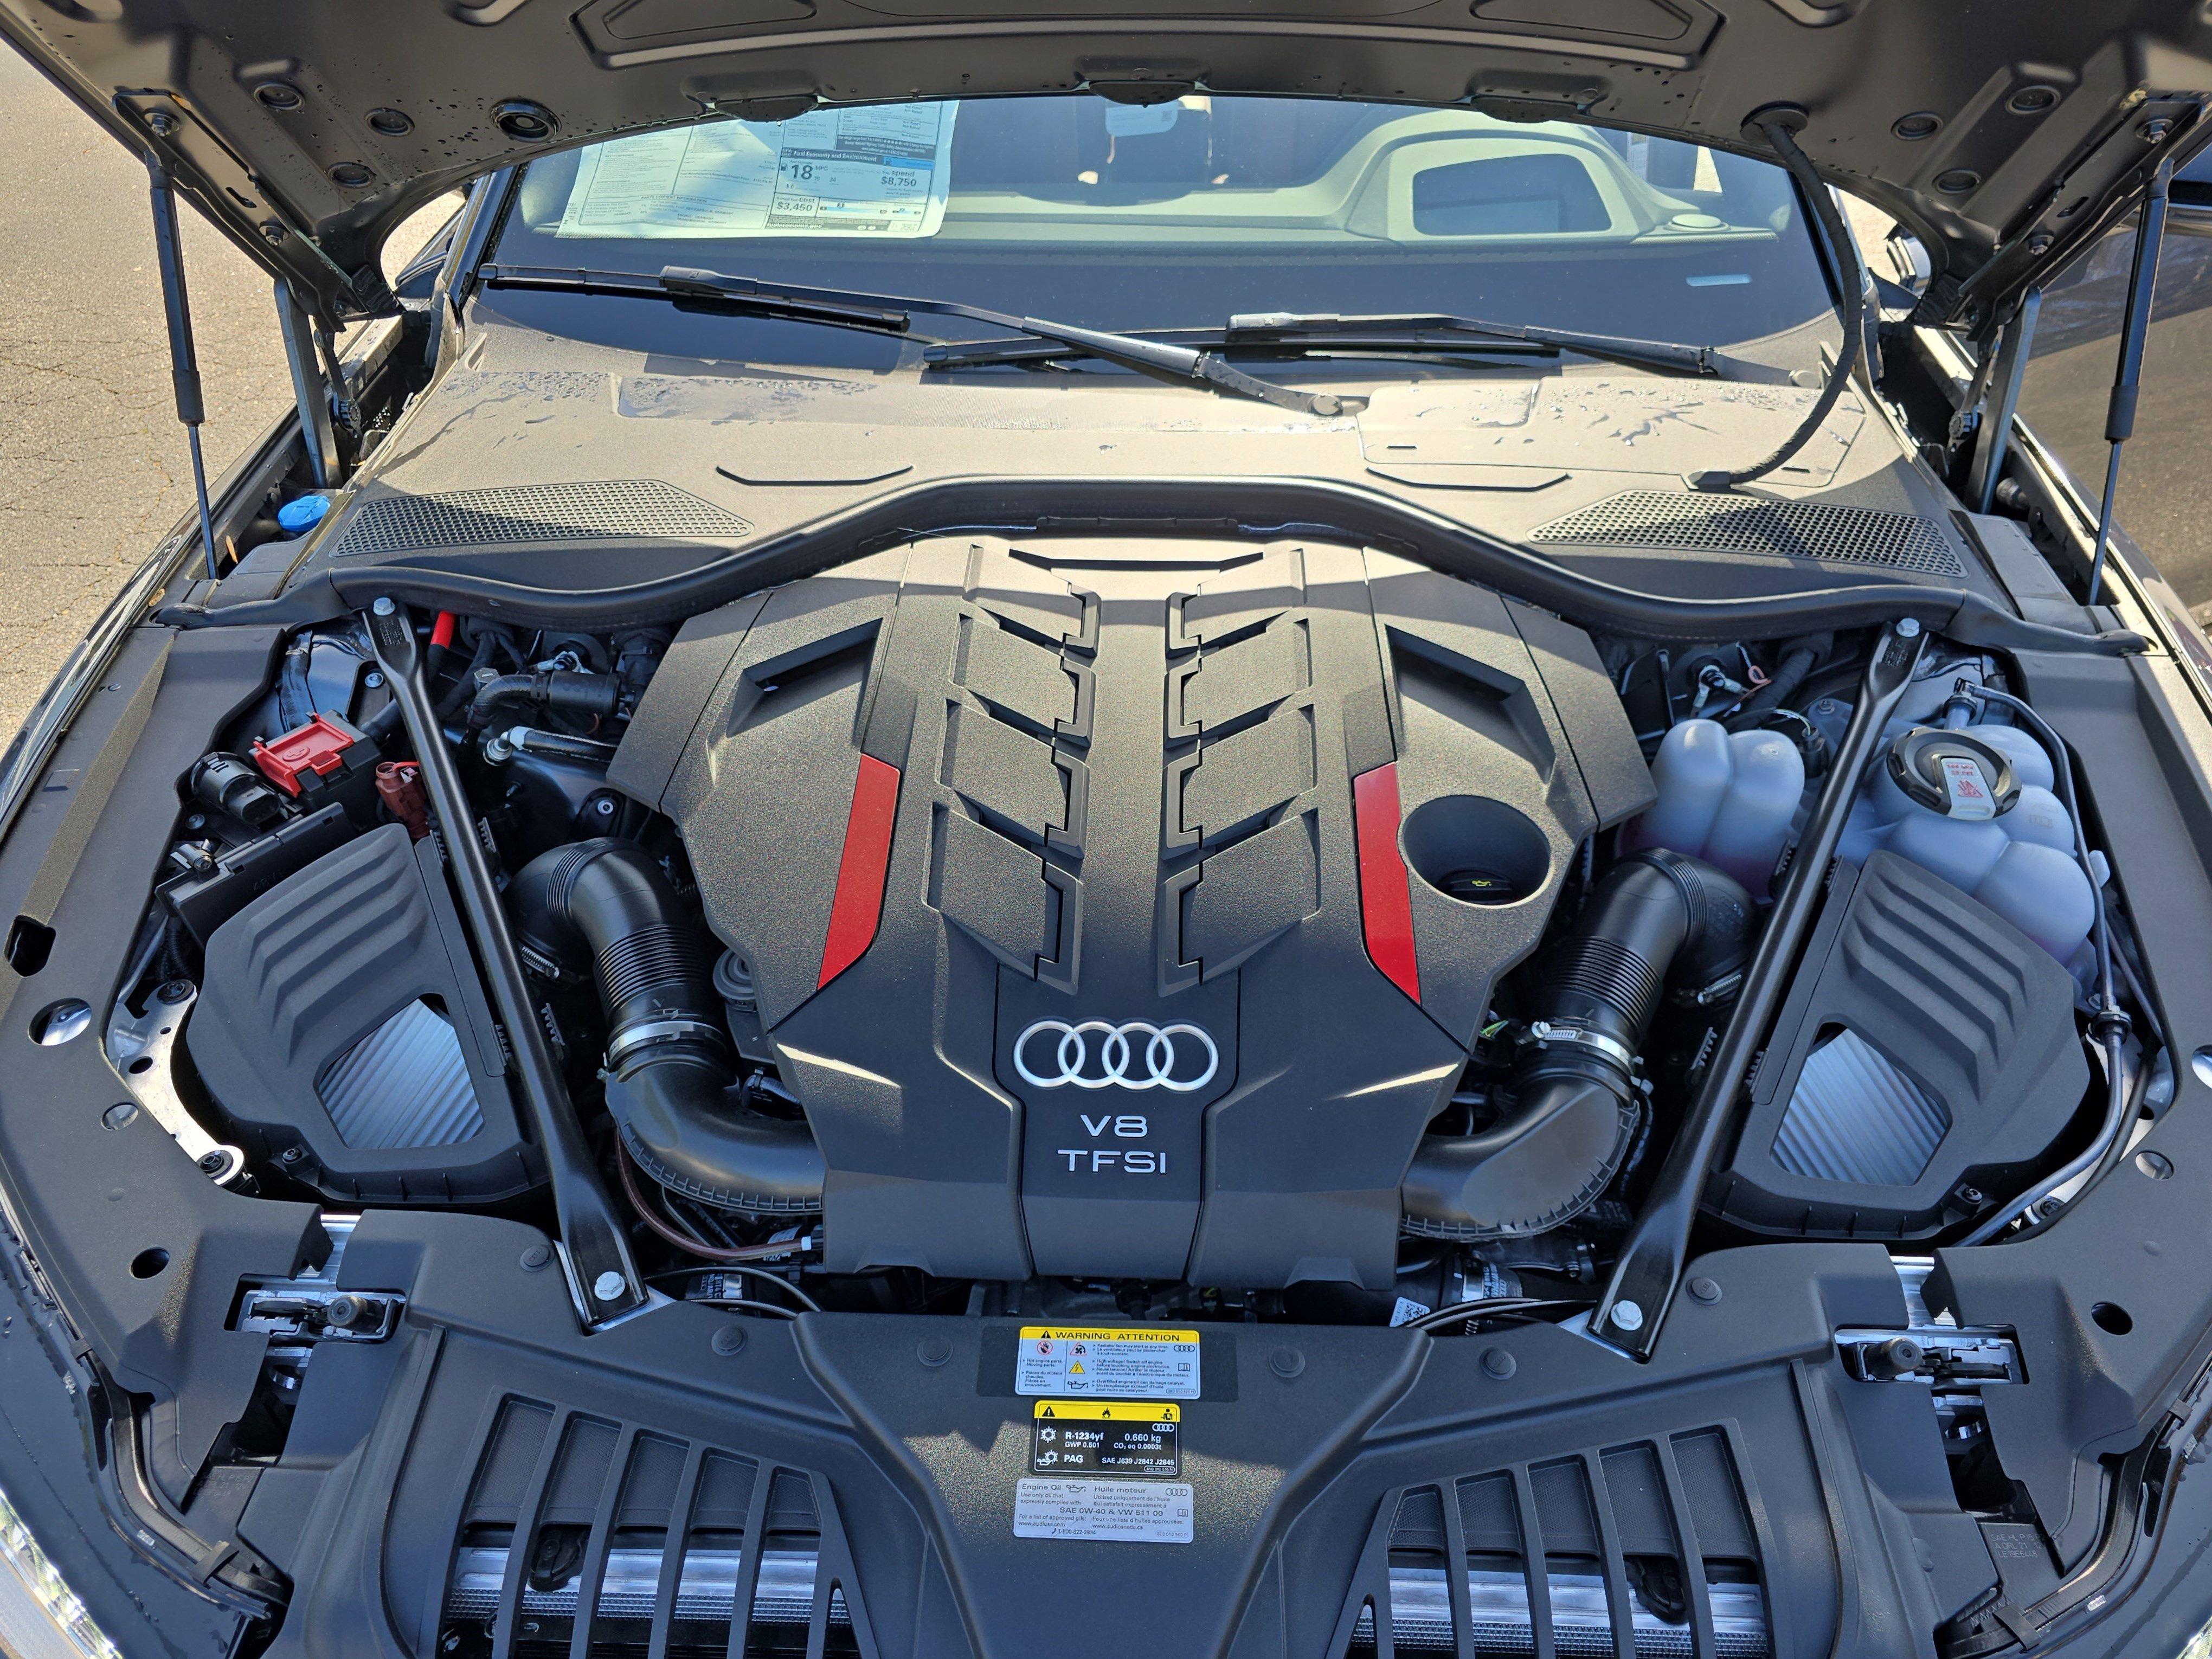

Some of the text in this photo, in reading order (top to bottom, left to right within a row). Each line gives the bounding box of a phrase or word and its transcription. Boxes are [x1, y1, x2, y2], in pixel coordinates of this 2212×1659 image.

[842, 153, 877, 162] Environment
[791, 164, 813, 180] 18
[880, 176, 917, 187] $8,750
[776, 202, 812, 212] $3,450
[1081, 1115, 1148, 1137] V8
[1057, 1150, 1166, 1173] TFSI
[1065, 1431, 1104, 1442] R-1234yf
[1151, 1434, 1161, 1443] kg
[1064, 1454, 1083, 1463] PAG
